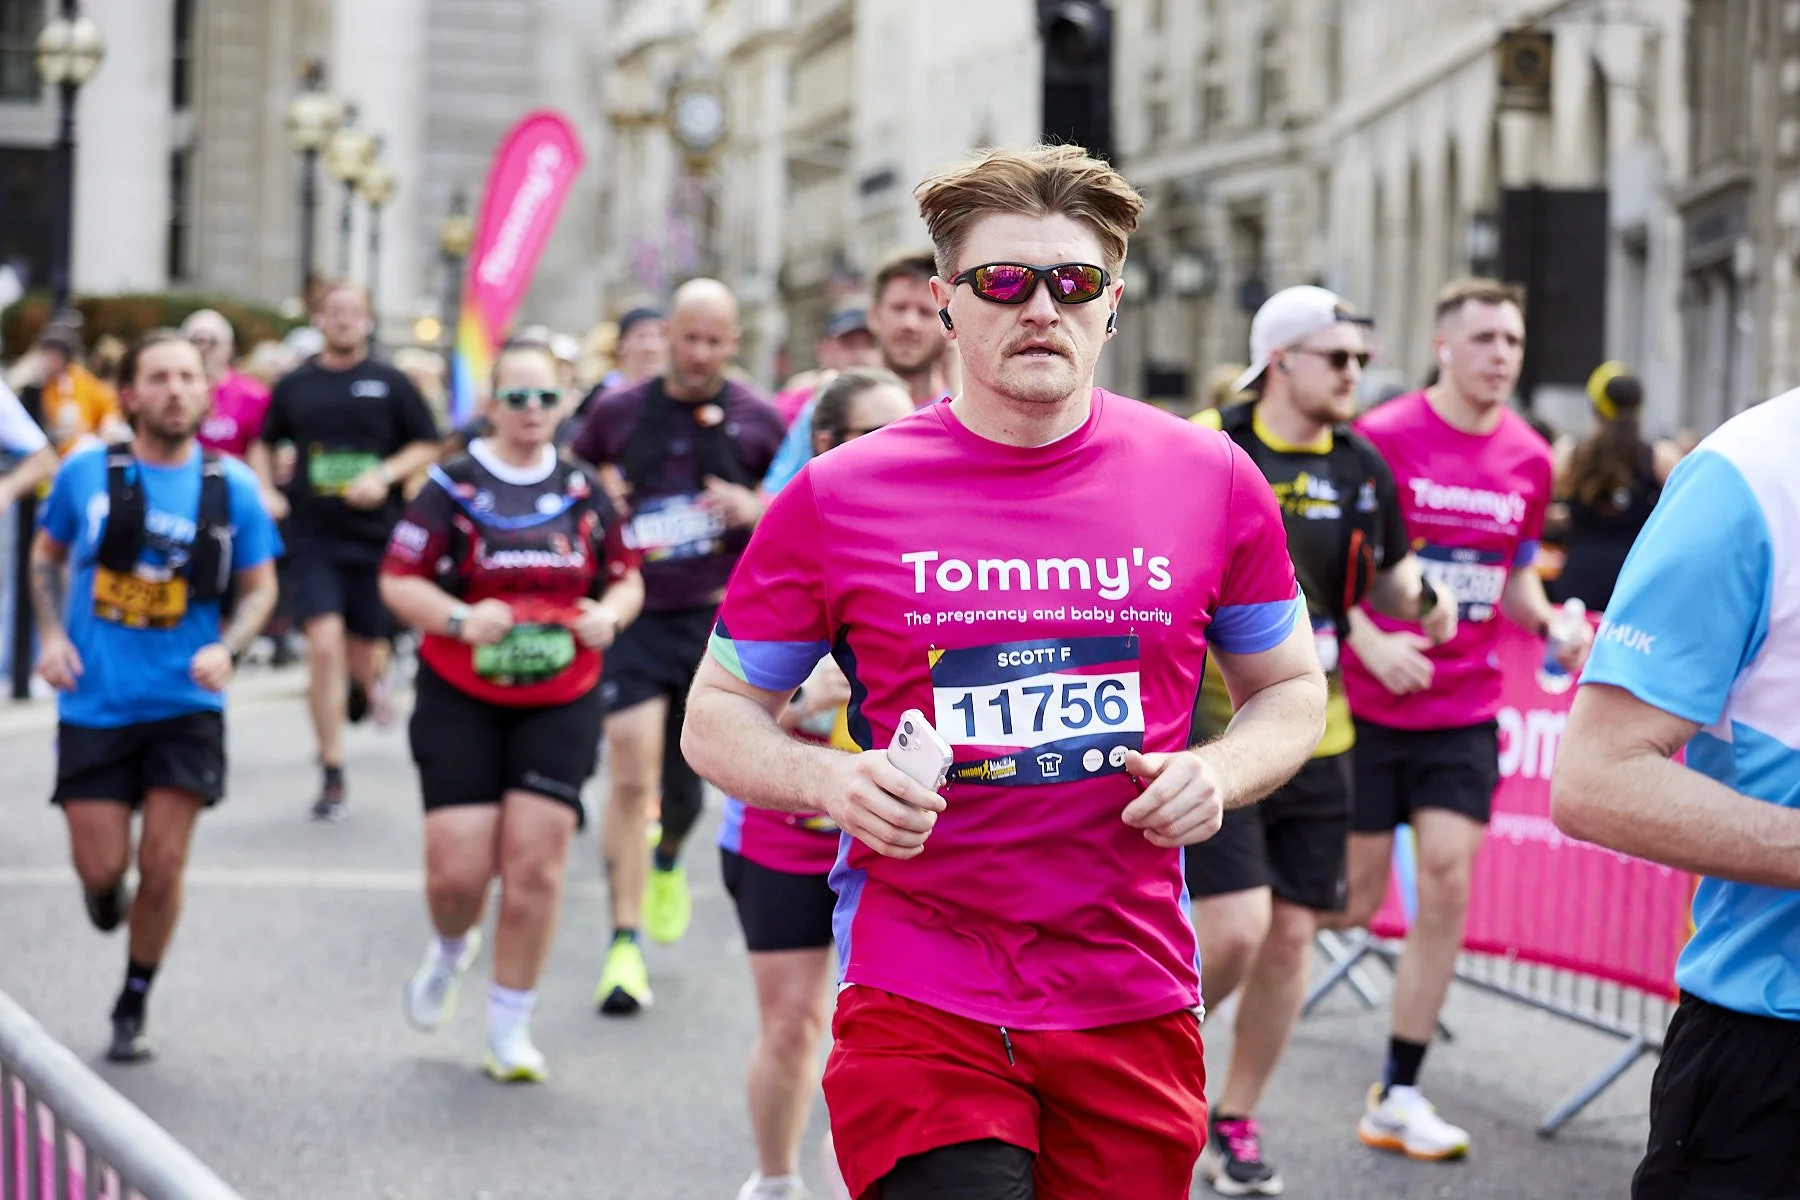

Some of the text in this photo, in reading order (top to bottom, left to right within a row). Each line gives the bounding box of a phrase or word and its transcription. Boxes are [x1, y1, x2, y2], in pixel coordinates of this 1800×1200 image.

[901, 547, 1172, 601] Tommy's
[903, 605, 1173, 627] The pregnancy and baby charity
[997, 646, 1072, 668] SCOTT F
[951, 678, 1130, 738] 11756
[957, 765, 984, 779] LONDON
[1045, 761, 1055, 773] XL
